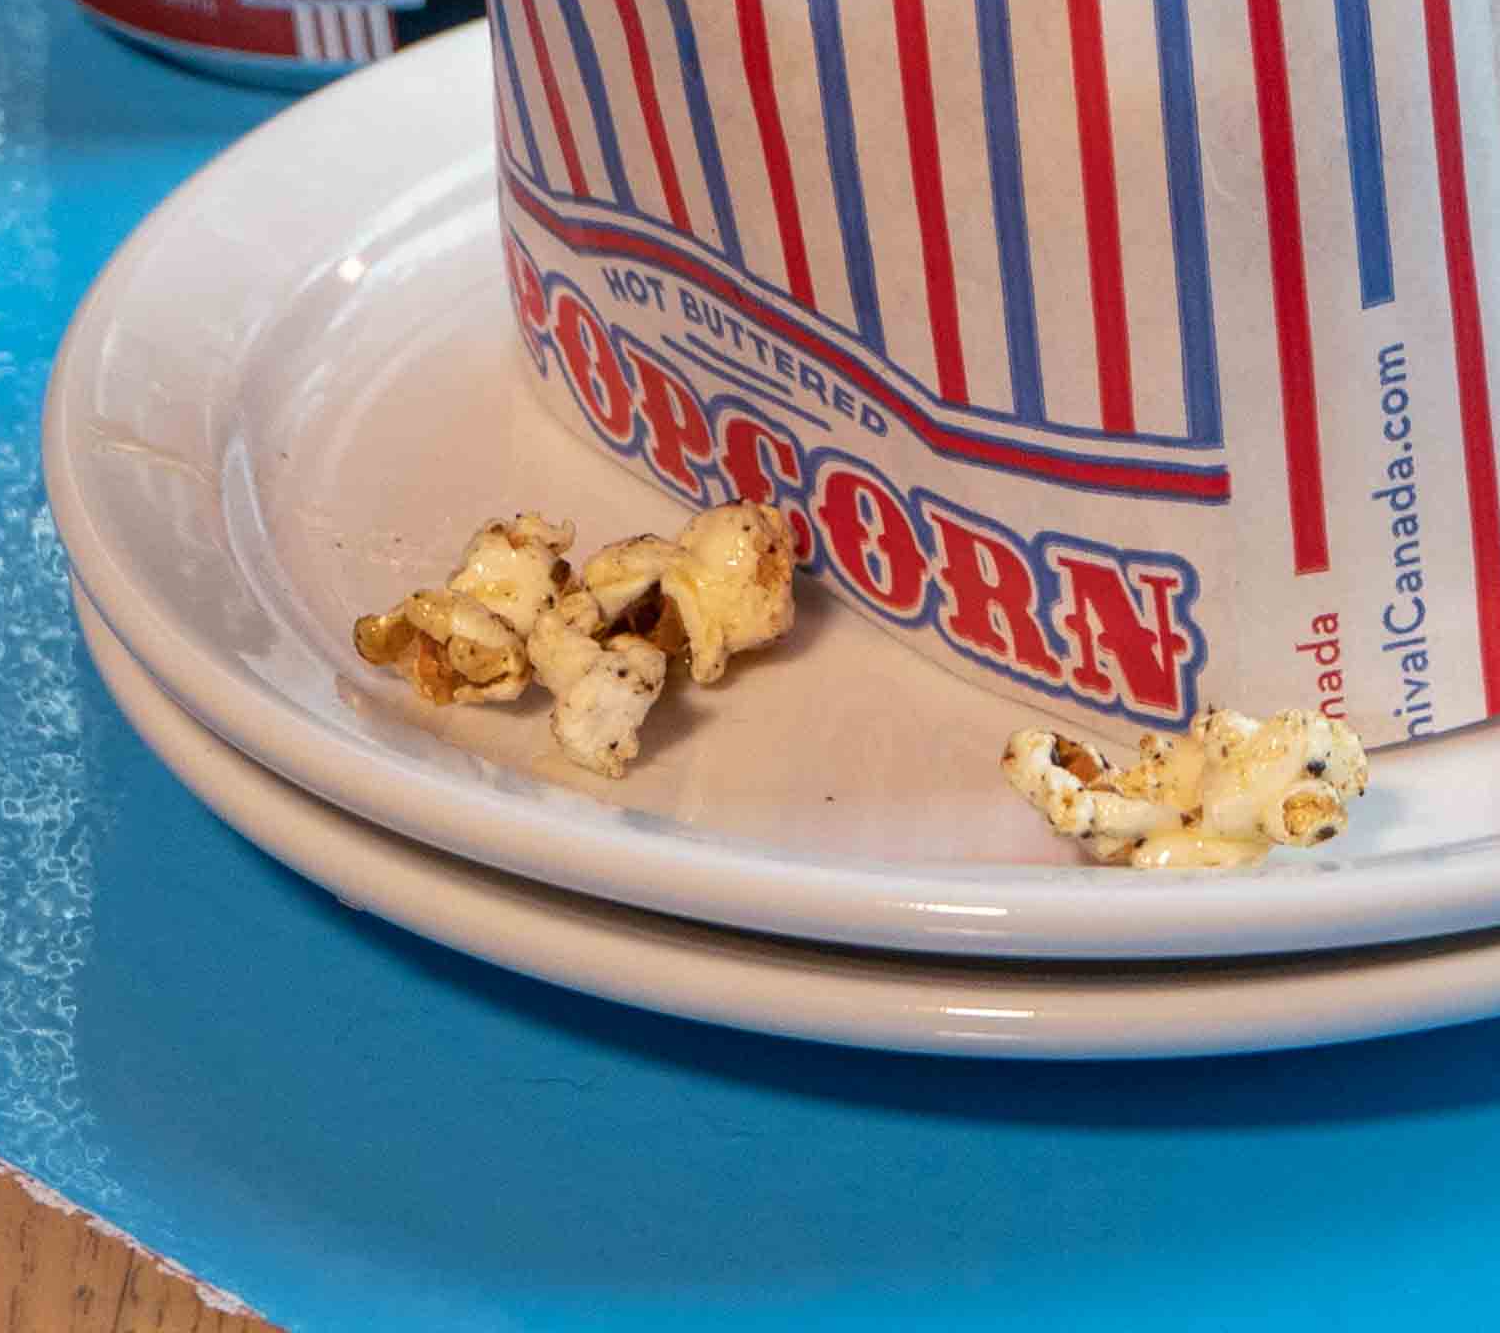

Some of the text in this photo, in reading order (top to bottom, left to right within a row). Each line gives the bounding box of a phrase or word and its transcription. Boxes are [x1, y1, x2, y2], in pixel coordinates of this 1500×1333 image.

[502, 225, 1202, 729] POPCORN
[602, 267, 888, 437] HOT BUTTERED
[1296, 612, 1346, 721] nada
[1372, 341, 1434, 741] nivalCanada.com
